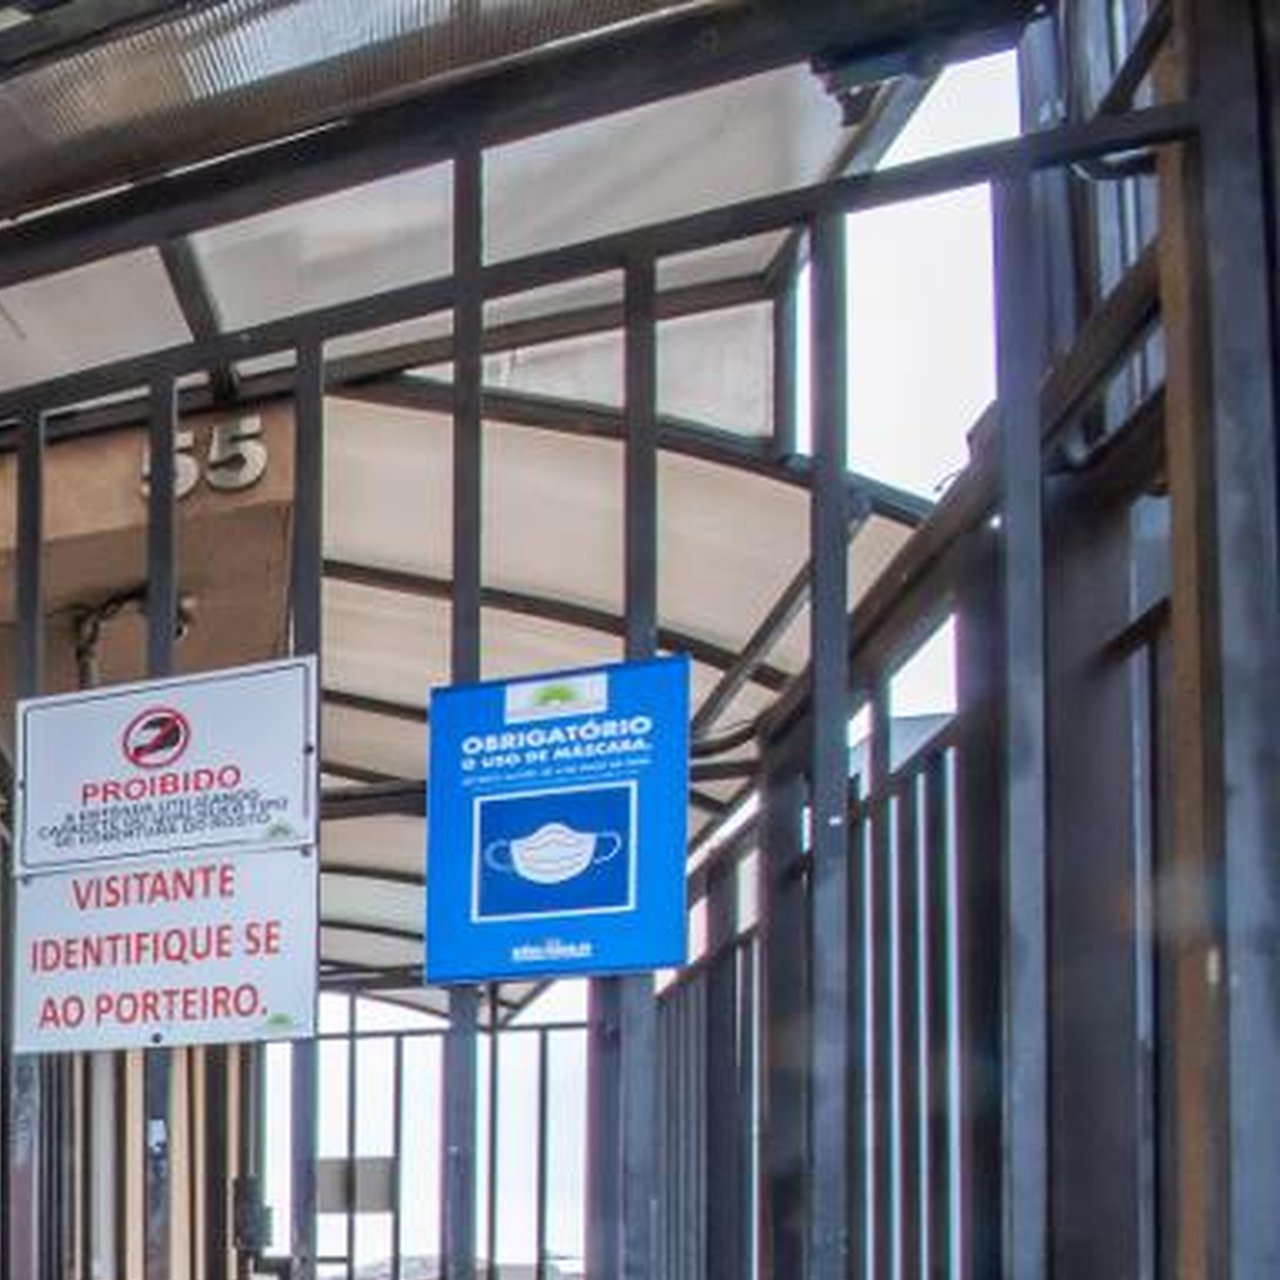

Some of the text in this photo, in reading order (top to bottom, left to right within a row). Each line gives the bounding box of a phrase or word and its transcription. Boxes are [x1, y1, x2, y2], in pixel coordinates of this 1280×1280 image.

[461, 715, 653, 755] OBRIGATÓRIO
[461, 757, 476, 772] O
[481, 752, 521, 769] USO
[526, 748, 549, 763] DE
[81, 765, 242, 806] PROIBIDO
[72, 864, 236, 911] VISITANTE
[31, 920, 282, 974] IDENTIFIQUE SE
[39, 983, 268, 1030] AO PORTEIRO.
